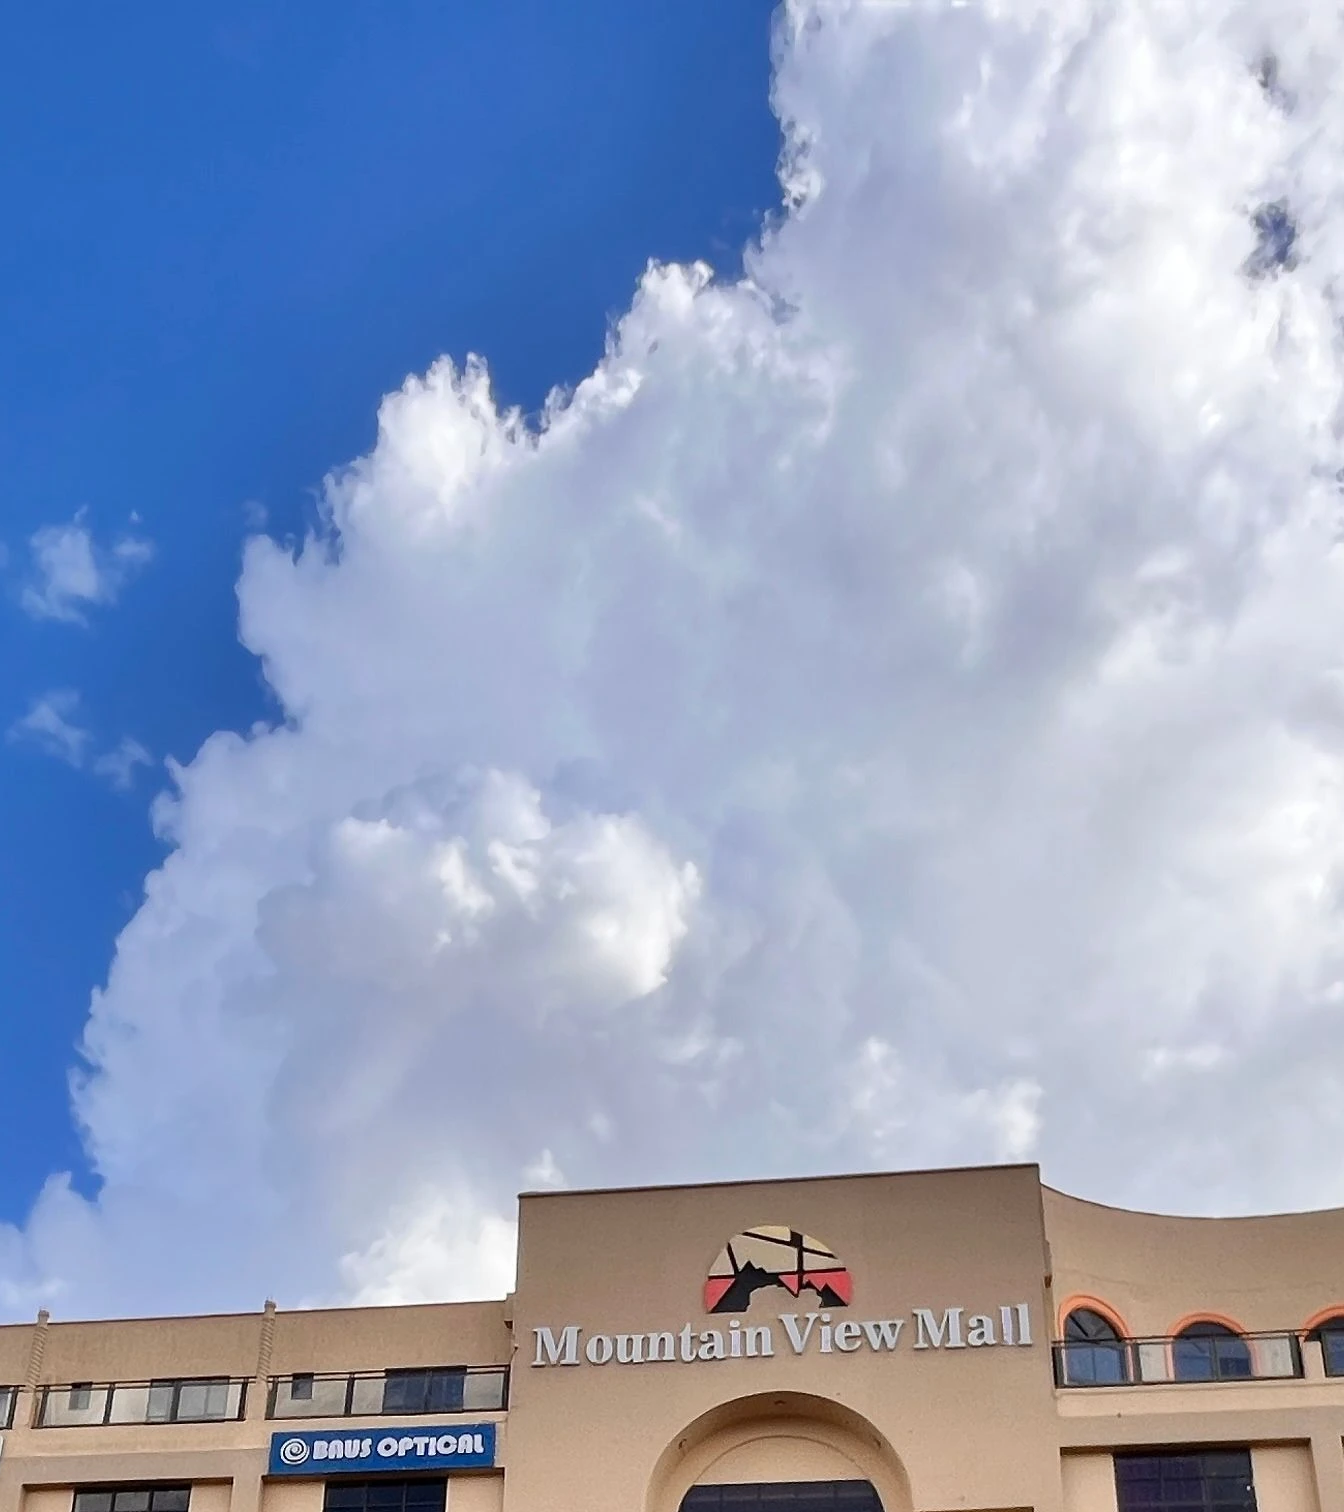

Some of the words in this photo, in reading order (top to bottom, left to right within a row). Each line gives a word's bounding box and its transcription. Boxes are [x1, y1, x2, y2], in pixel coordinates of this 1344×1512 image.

[531, 1319, 775, 1368] Mountain
[777, 1311, 905, 1355] View
[912, 1302, 1034, 1351] Mall
[312, 1438, 373, 1460] BAUS
[376, 1433, 485, 1458] OPTICAL
